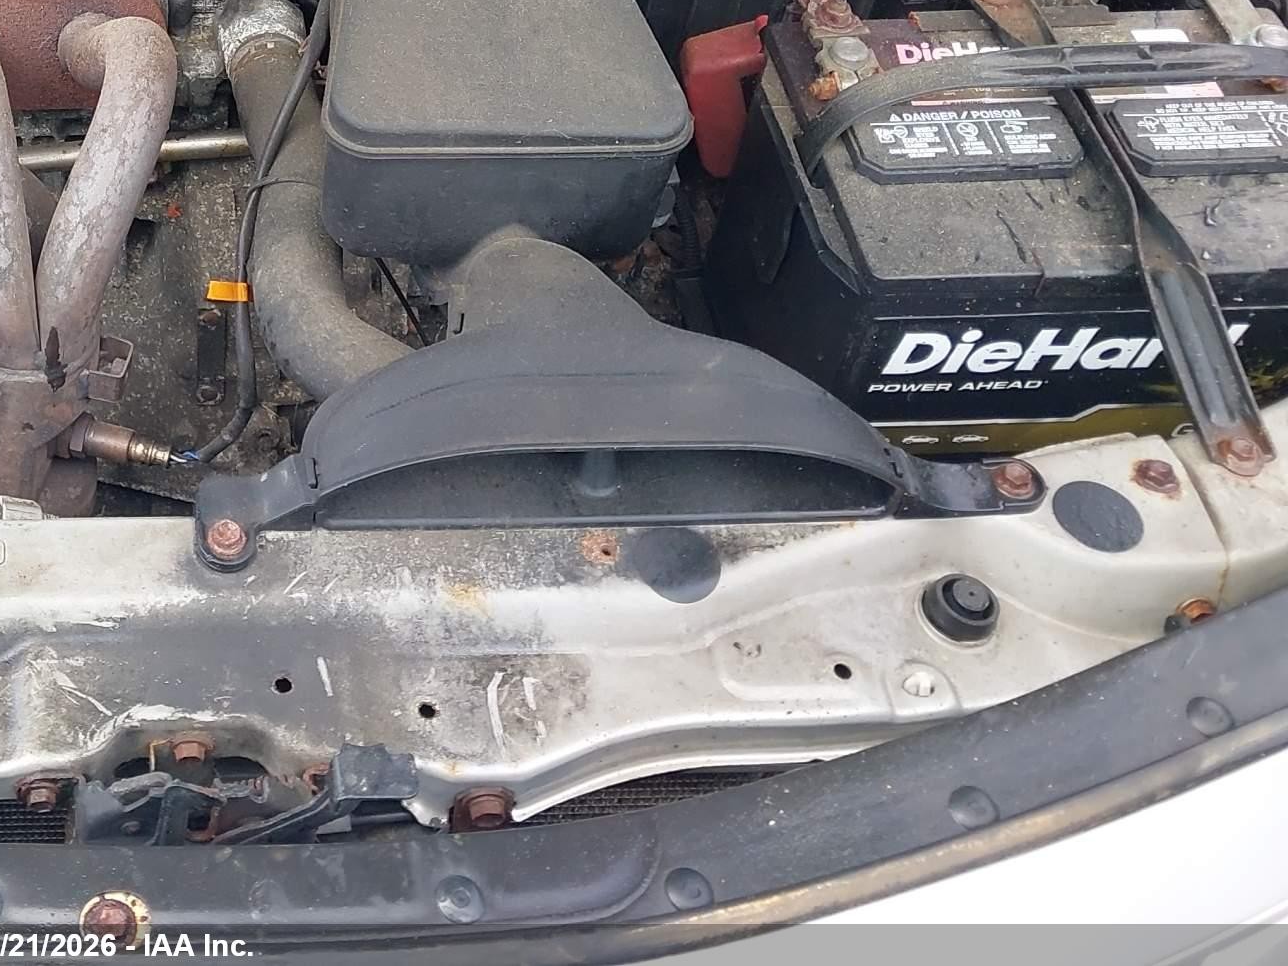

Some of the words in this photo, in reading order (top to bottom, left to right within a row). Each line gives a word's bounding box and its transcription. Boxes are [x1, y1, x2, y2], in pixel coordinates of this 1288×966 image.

[902, 112, 958, 122] DANGER
[970, 109, 1023, 119] POISON
[881, 324, 1251, 376] DieHar
[868, 382, 957, 394] POWER
